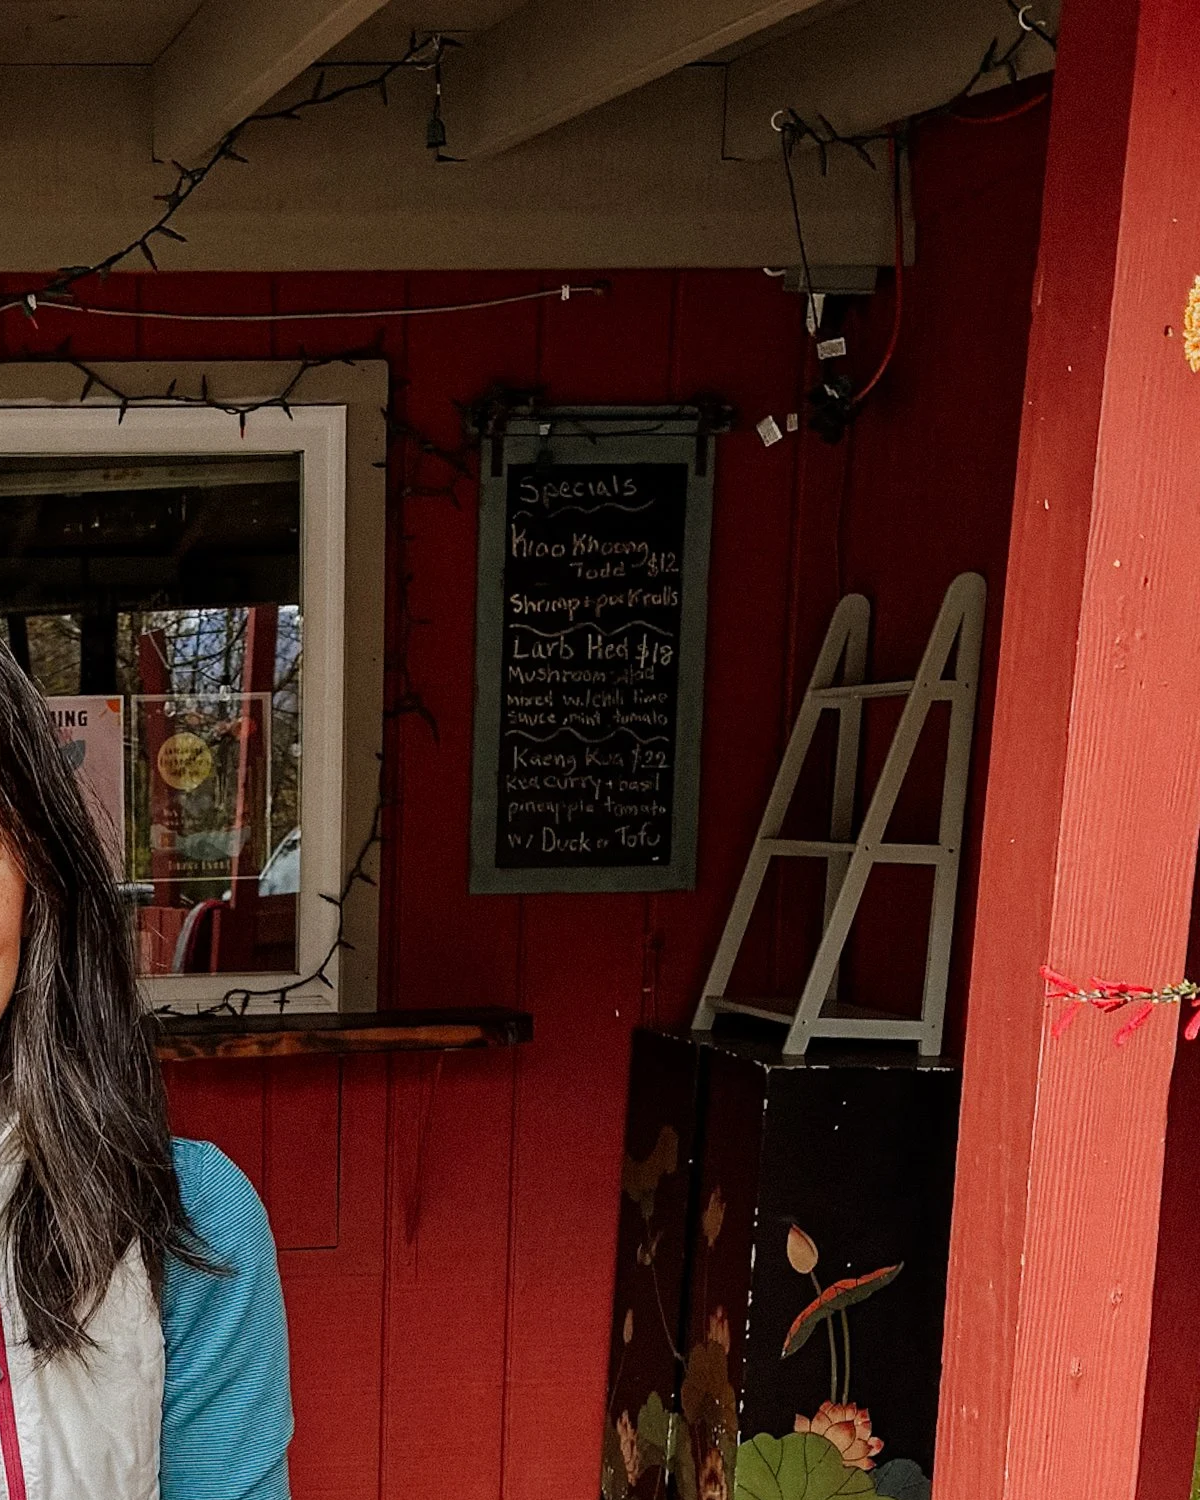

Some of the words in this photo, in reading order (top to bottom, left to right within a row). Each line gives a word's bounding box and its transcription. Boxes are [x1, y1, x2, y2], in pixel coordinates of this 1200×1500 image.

[520, 475, 638, 509] Specials
[569, 561, 626, 580] Todd
[647, 552, 680, 577] $12
[509, 593, 580, 621] Shrimp
[513, 636, 575, 660] Larb
[587, 633, 630, 661] Hed
[635, 633, 674, 669] $18
[508, 664, 607, 685] Mushroom
[507, 689, 554, 707] mixed
[634, 689, 669, 706] lime
[513, 746, 578, 776] Kaeng
[632, 743, 671, 773] $22
[543, 775, 601, 800] curry
[508, 800, 595, 824] pineapple
[541, 826, 593, 852] Duck
[614, 821, 661, 848] Tofu
